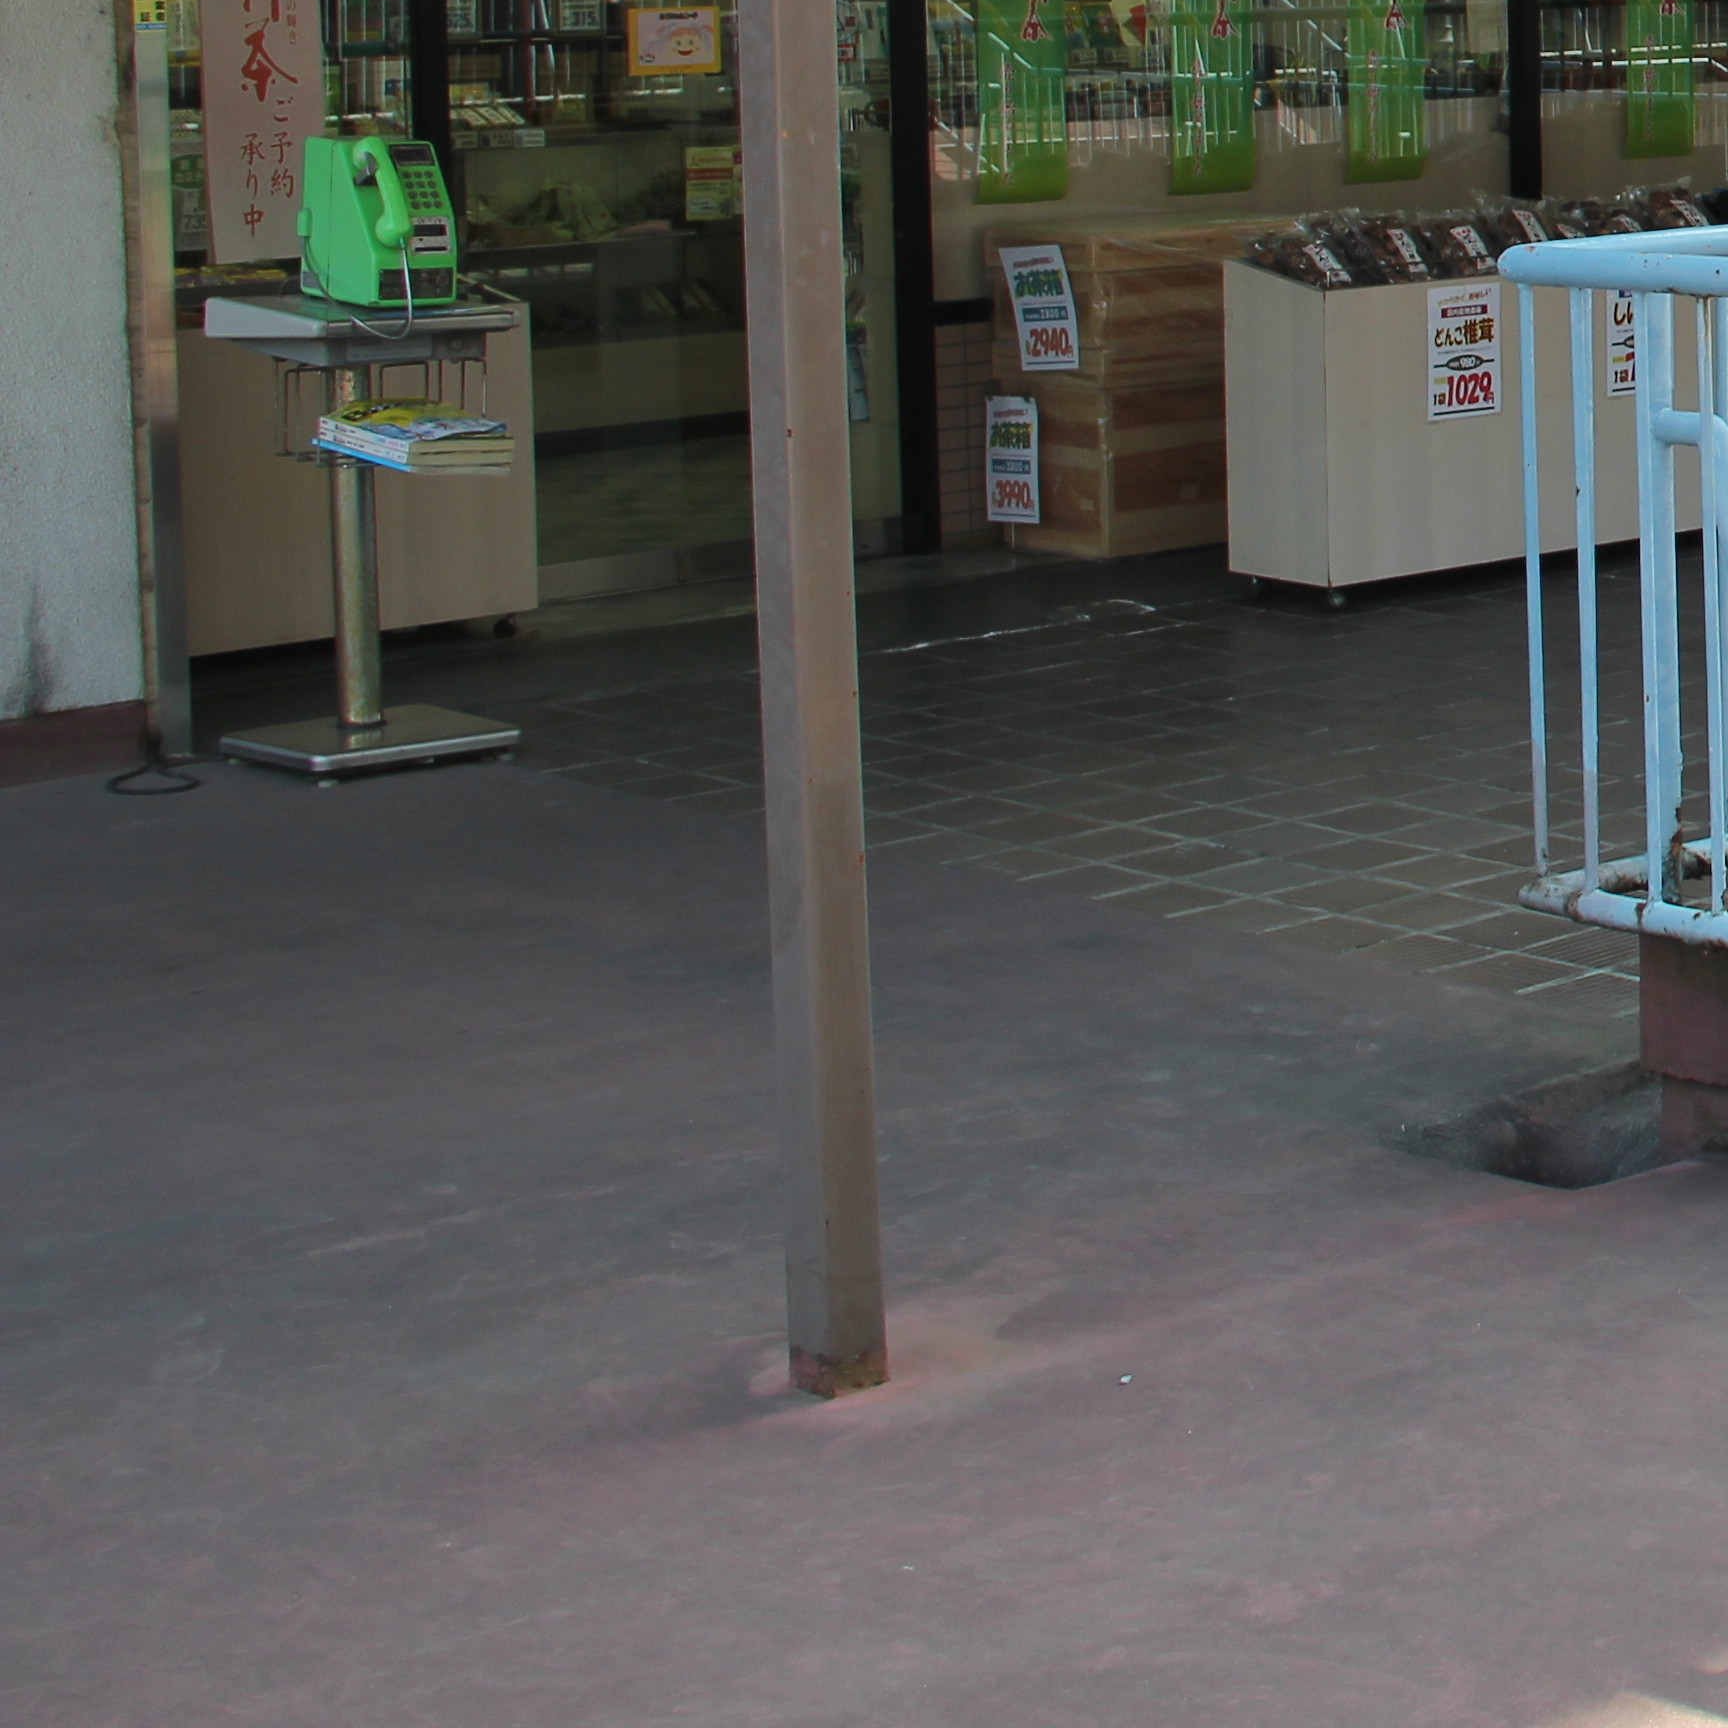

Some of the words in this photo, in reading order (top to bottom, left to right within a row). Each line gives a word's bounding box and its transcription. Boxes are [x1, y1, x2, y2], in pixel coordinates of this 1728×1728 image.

[240, 133, 266, 238] 承り中
[270, 95, 296, 200] ご予約
[1433, 317, 1495, 348] どんこ椎茸
